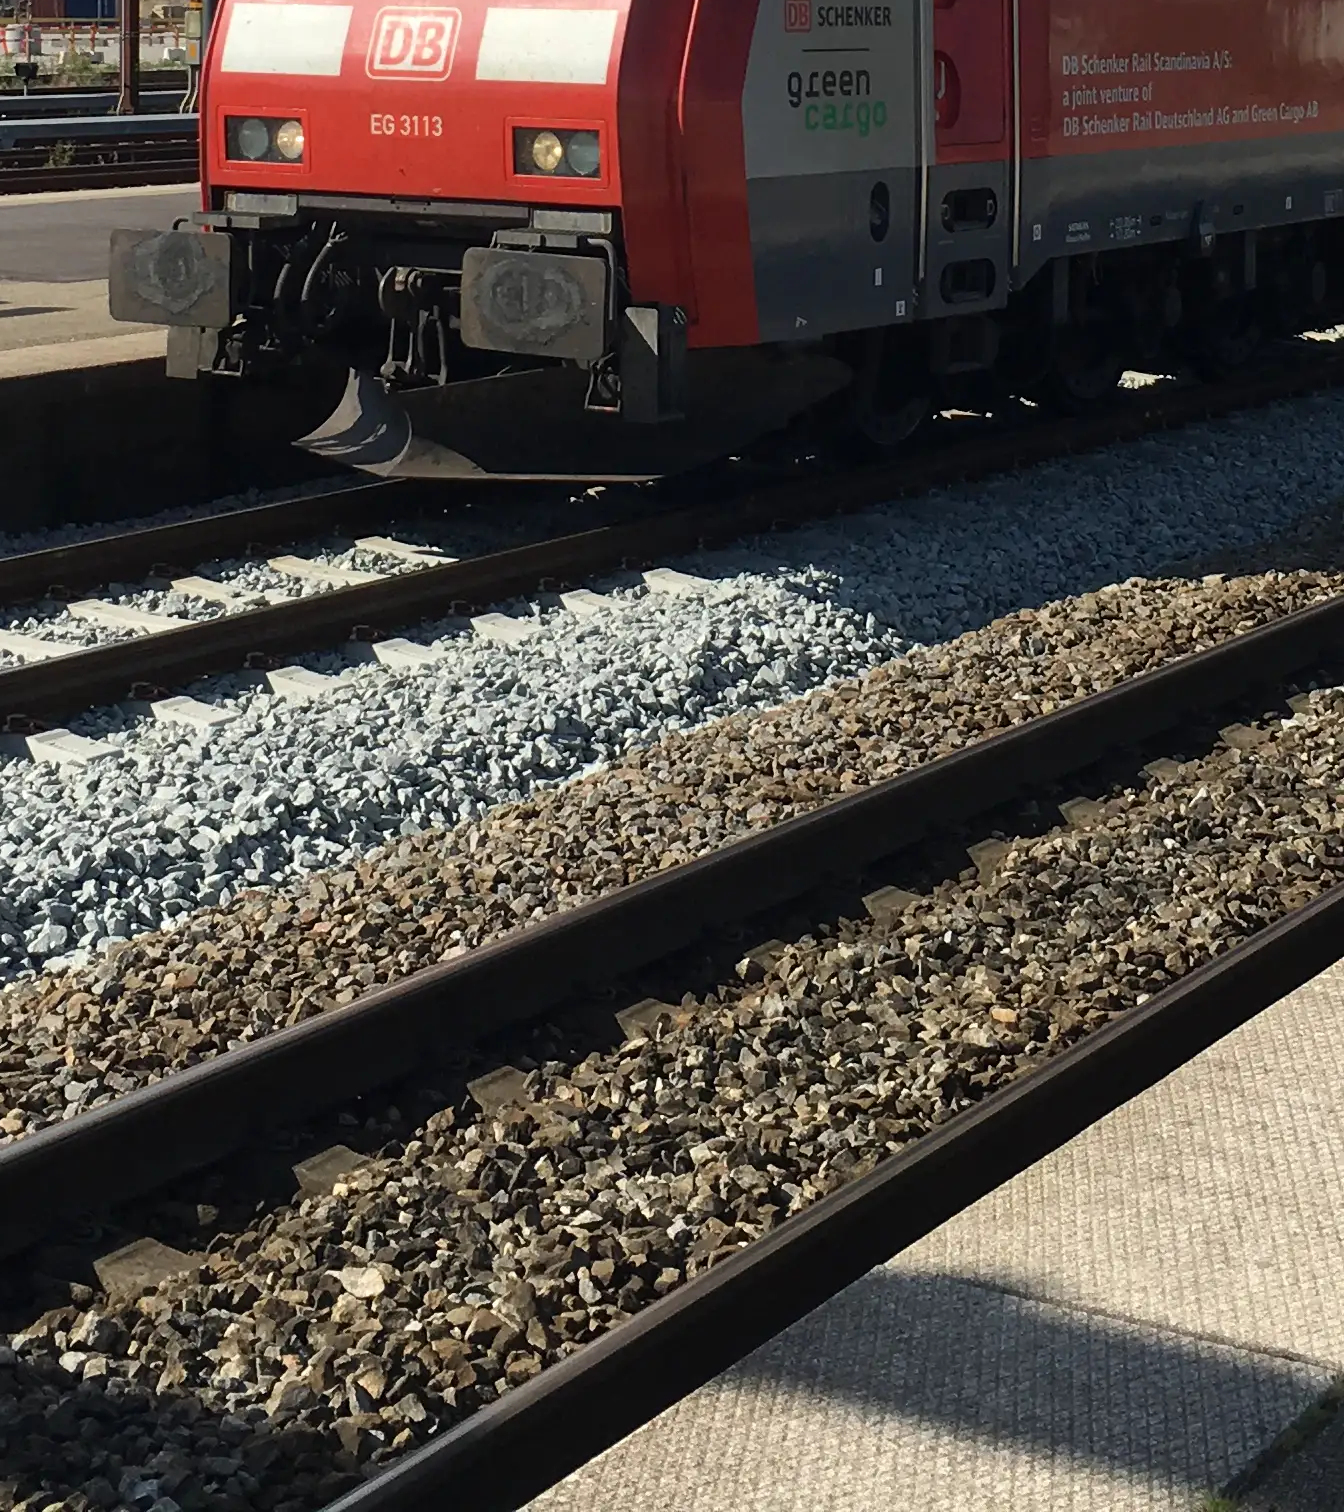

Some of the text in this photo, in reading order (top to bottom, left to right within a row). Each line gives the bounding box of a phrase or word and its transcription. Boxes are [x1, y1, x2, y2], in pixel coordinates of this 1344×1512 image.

[788, 3, 892, 27] DB SCHENKER
[378, 19, 446, 67] DB
[1062, 55, 1079, 76] DB
[1081, 52, 1130, 75] Schenker
[1131, 52, 1152, 73] Rail
[1153, 50, 1210, 73] Scandinavia
[787, 69, 870, 108] green
[1062, 82, 1153, 111] a joint venture of
[370, 113, 444, 137] EG 3113
[805, 101, 888, 138] cargo
[1063, 117, 1081, 137] DB
[1082, 113, 1131, 136] Schenker
[1132, 112, 1153, 132] Rail
[1154, 106, 1214, 130] Deutschland
[1216, 105, 1230, 125] AG
[1231, 104, 1250, 124] and
[1251, 104, 1278, 122] Green
[1306, 100, 1319, 118] AB
